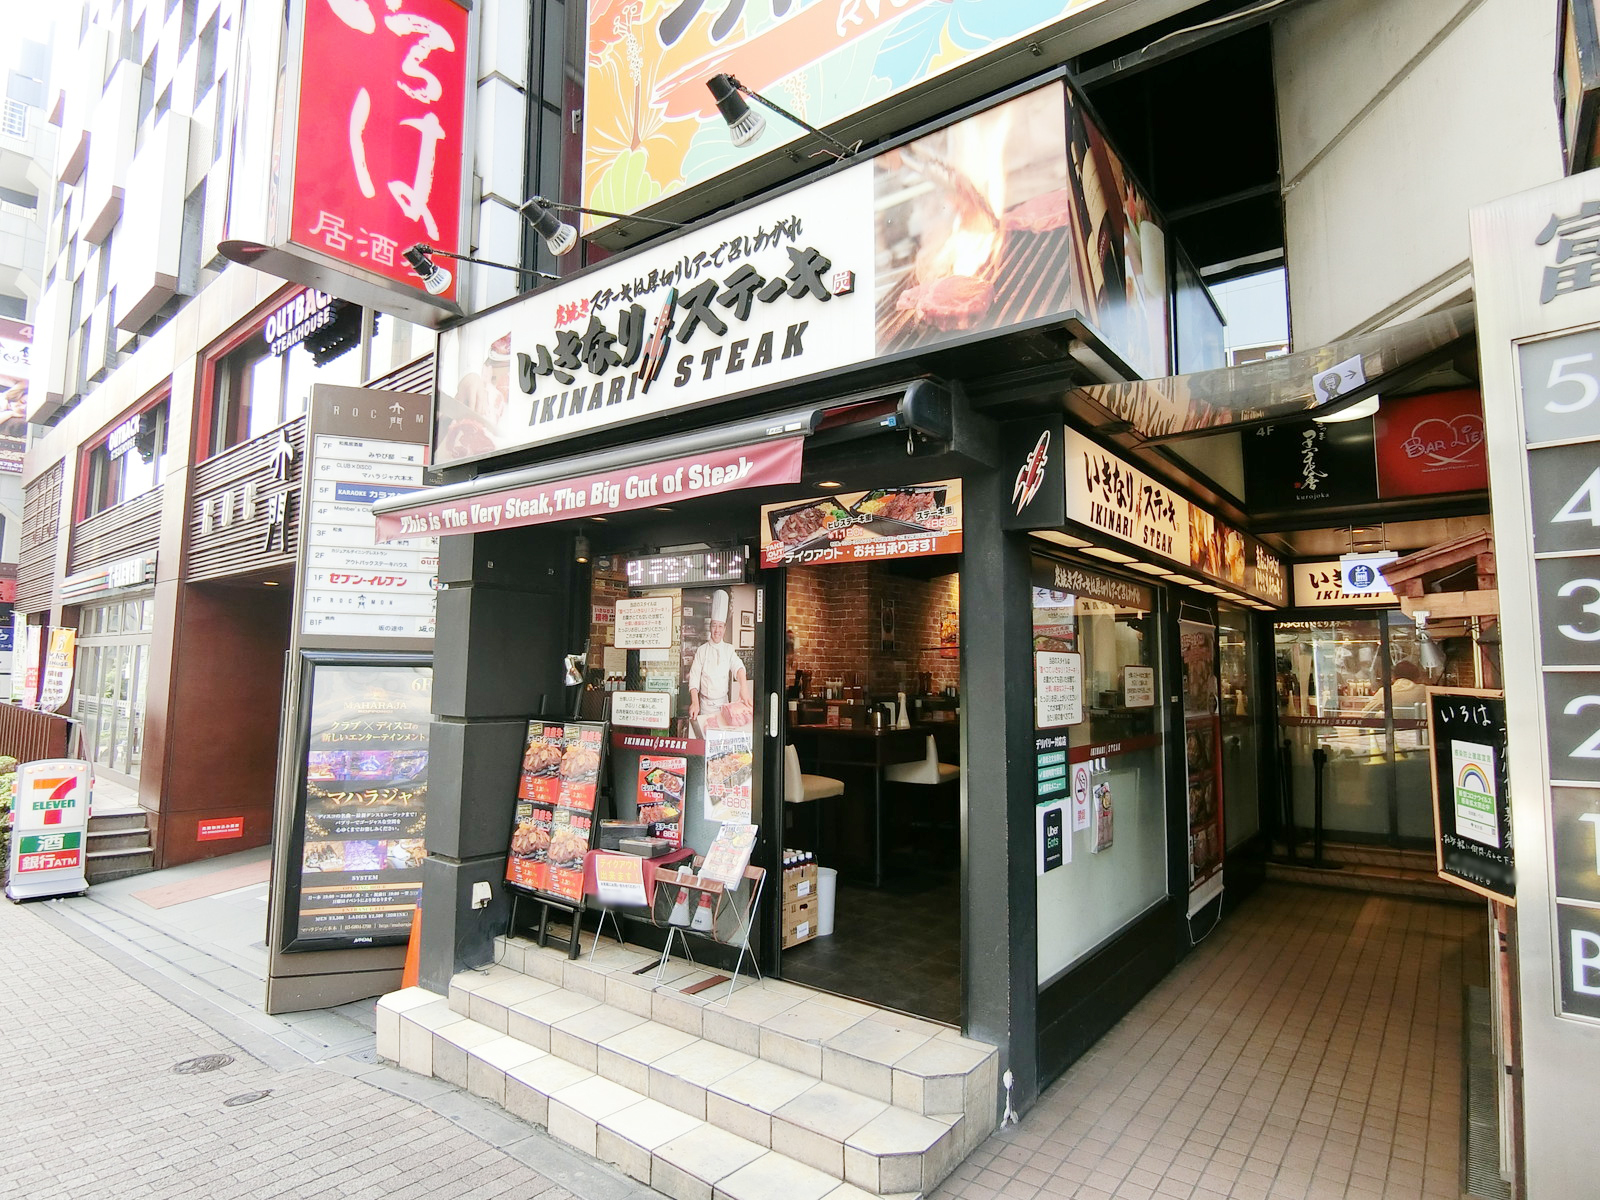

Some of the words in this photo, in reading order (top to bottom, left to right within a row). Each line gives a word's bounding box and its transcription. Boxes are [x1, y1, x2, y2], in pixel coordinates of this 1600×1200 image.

[309, 210, 440, 277] 居酒
[517, 302, 648, 395] いきなり
[676, 246, 833, 345] ステーキ
[270, 305, 331, 357] STEAKHOUSE
[528, 370, 640, 427] IKINARI
[673, 320, 810, 389] STEAK
[1543, 352, 1600, 414] 5
[1256, 425, 1274, 437] 4F
[1400, 436, 1447, 459] BAR
[362, 472, 414, 481] マハラジャ六本木
[338, 489, 367, 497] KARAOKE
[400, 513, 428, 534] This
[428, 510, 441, 531] is
[442, 507, 468, 529] The
[470, 504, 502, 530] Very
[505, 497, 554, 521] Steak,
[553, 490, 586, 511] The
[591, 482, 621, 508] Big
[625, 476, 658, 499] Cut
[662, 470, 684, 492] of
[688, 457, 754, 489] Steak
[1083, 451, 1134, 513] いきなり
[1143, 484, 1177, 533] ステーキ
[1296, 492, 1330, 500] kurojoka
[1549, 465, 1600, 528] 4
[915, 504, 954, 522] ステーキ重
[1090, 500, 1134, 539] IKINARI
[1143, 526, 1174, 555] STEAK
[766, 541, 785, 551] TAKE
[768, 549, 785, 557] OUT
[345, 559, 408, 568] アウトバックステーキハウス
[1556, 578, 1600, 642] 3
[343, 701, 408, 710] MAHARAJA
[1440, 704, 1492, 727] いろは
[1562, 695, 1600, 758] 2
[321, 733, 427, 743] 新しいエンターテインメント
[624, 737, 654, 746] IKINARI
[658, 739, 688, 750] STEAK
[1454, 749, 1491, 763] 感染防止徹底宣言
[327, 788, 414, 806] マハラジャ
[709, 784, 749, 797] ステーキ重
[1458, 789, 1492, 804] 新型コロナウイルス
[1046, 824, 1059, 838] Uber
[37, 833, 65, 851] 酒
[1047, 837, 1059, 849] Eats
[22, 854, 78, 871] 銀行ATM
[600, 858, 639, 871] テイクアウト
[351, 874, 379, 882] SYSTEM
[1570, 928, 1600, 997] B
